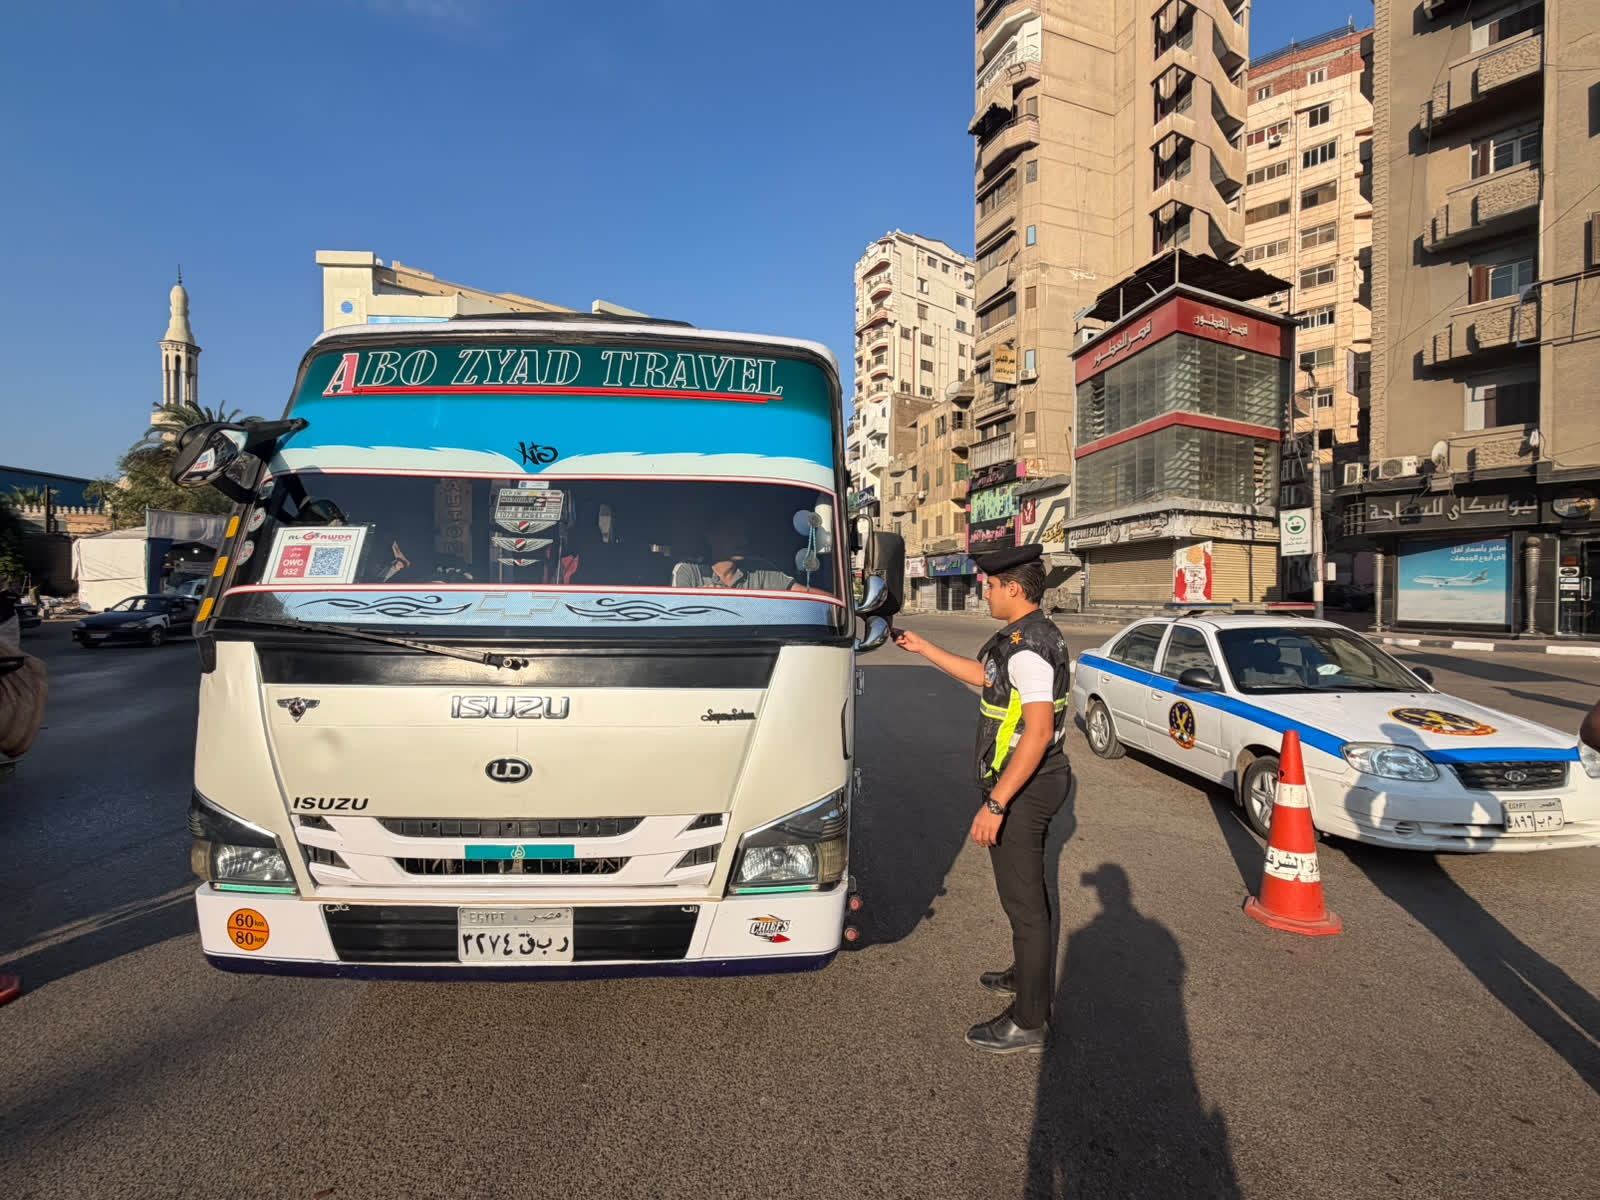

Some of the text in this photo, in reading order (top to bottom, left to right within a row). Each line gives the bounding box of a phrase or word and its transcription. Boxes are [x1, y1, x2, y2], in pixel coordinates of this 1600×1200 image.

[323, 349, 784, 396] ABO ZYAD TRAVEL
[451, 695, 570, 719] ISUZU
[491, 761, 526, 779] UD
[293, 797, 369, 811] ISUZU
[235, 913, 265, 928] 60 km
[469, 911, 505, 923] EGYPT
[528, 911, 562, 923] مصر
[750, 920, 790, 935] CHIEFS
[235, 930, 254, 946] 80
[462, 933, 513, 956] ٣٢٧٤
